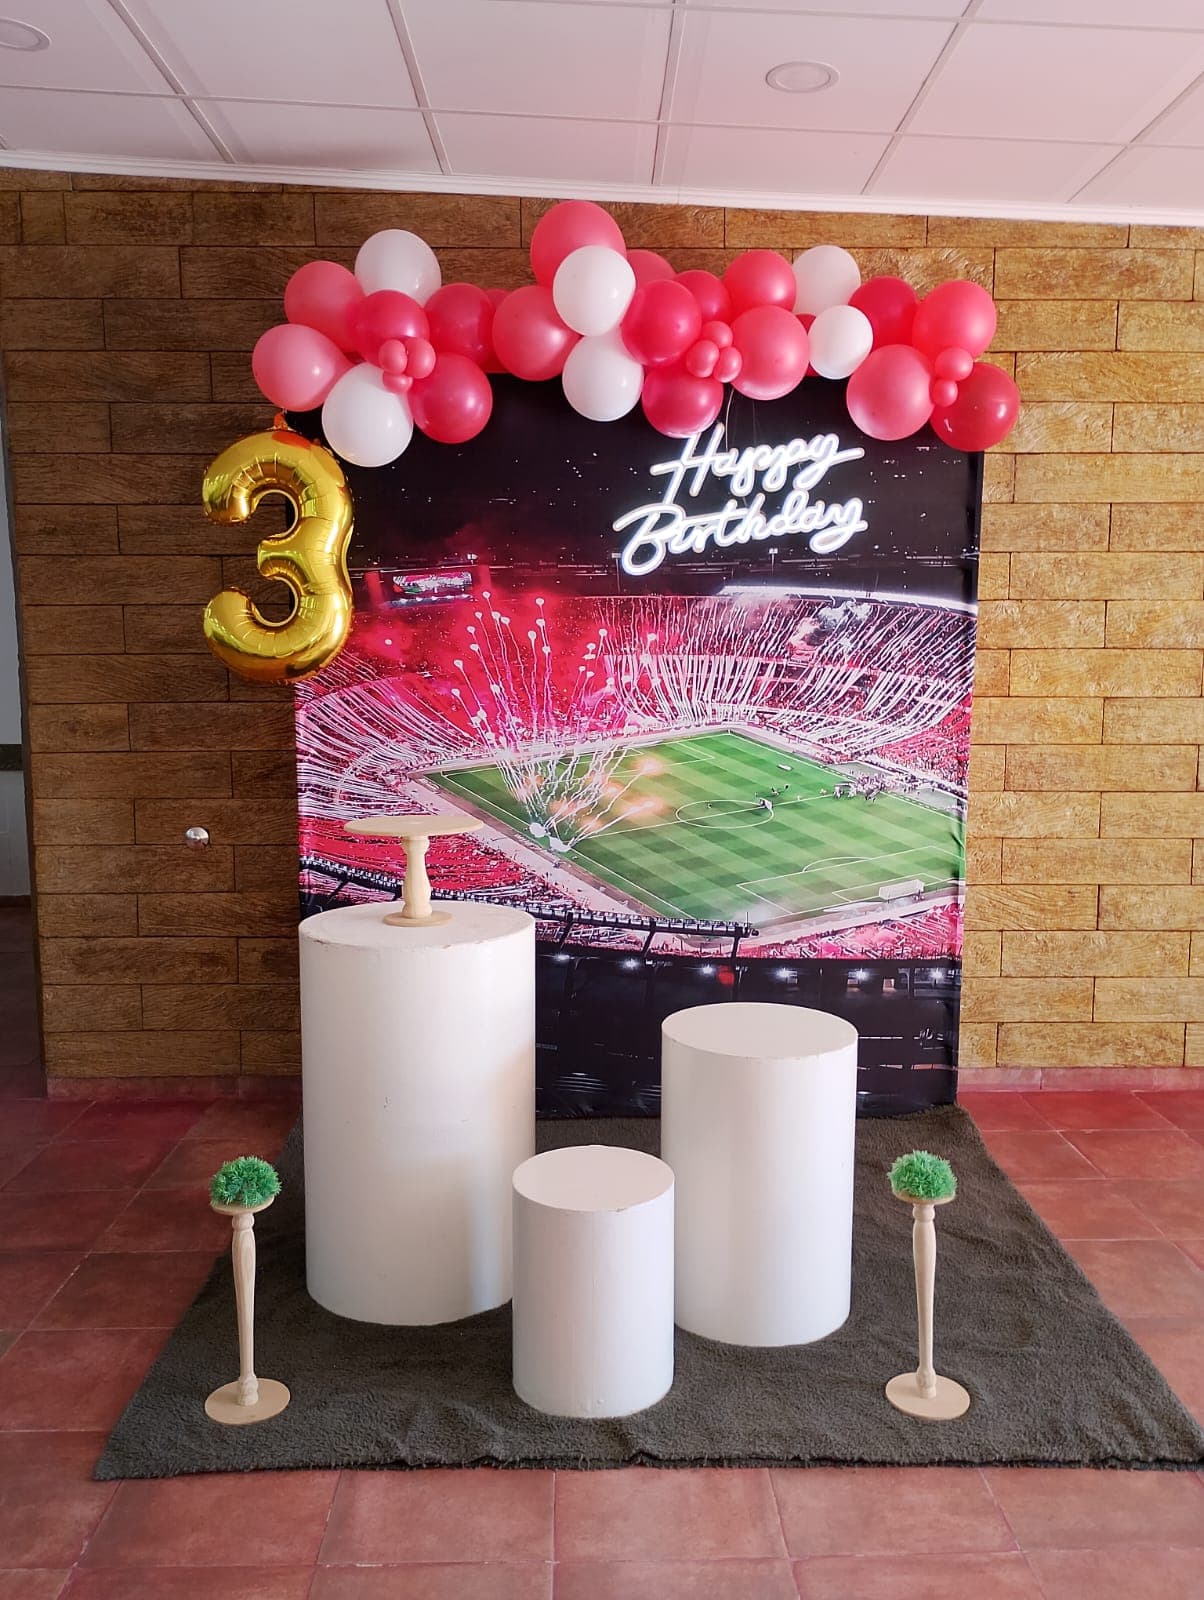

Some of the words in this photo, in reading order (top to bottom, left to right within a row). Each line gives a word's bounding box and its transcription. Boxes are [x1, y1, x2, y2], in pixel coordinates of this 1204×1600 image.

[650, 422, 865, 504] Happy
[202, 429, 354, 683] 3
[612, 488, 869, 576] Birthday
